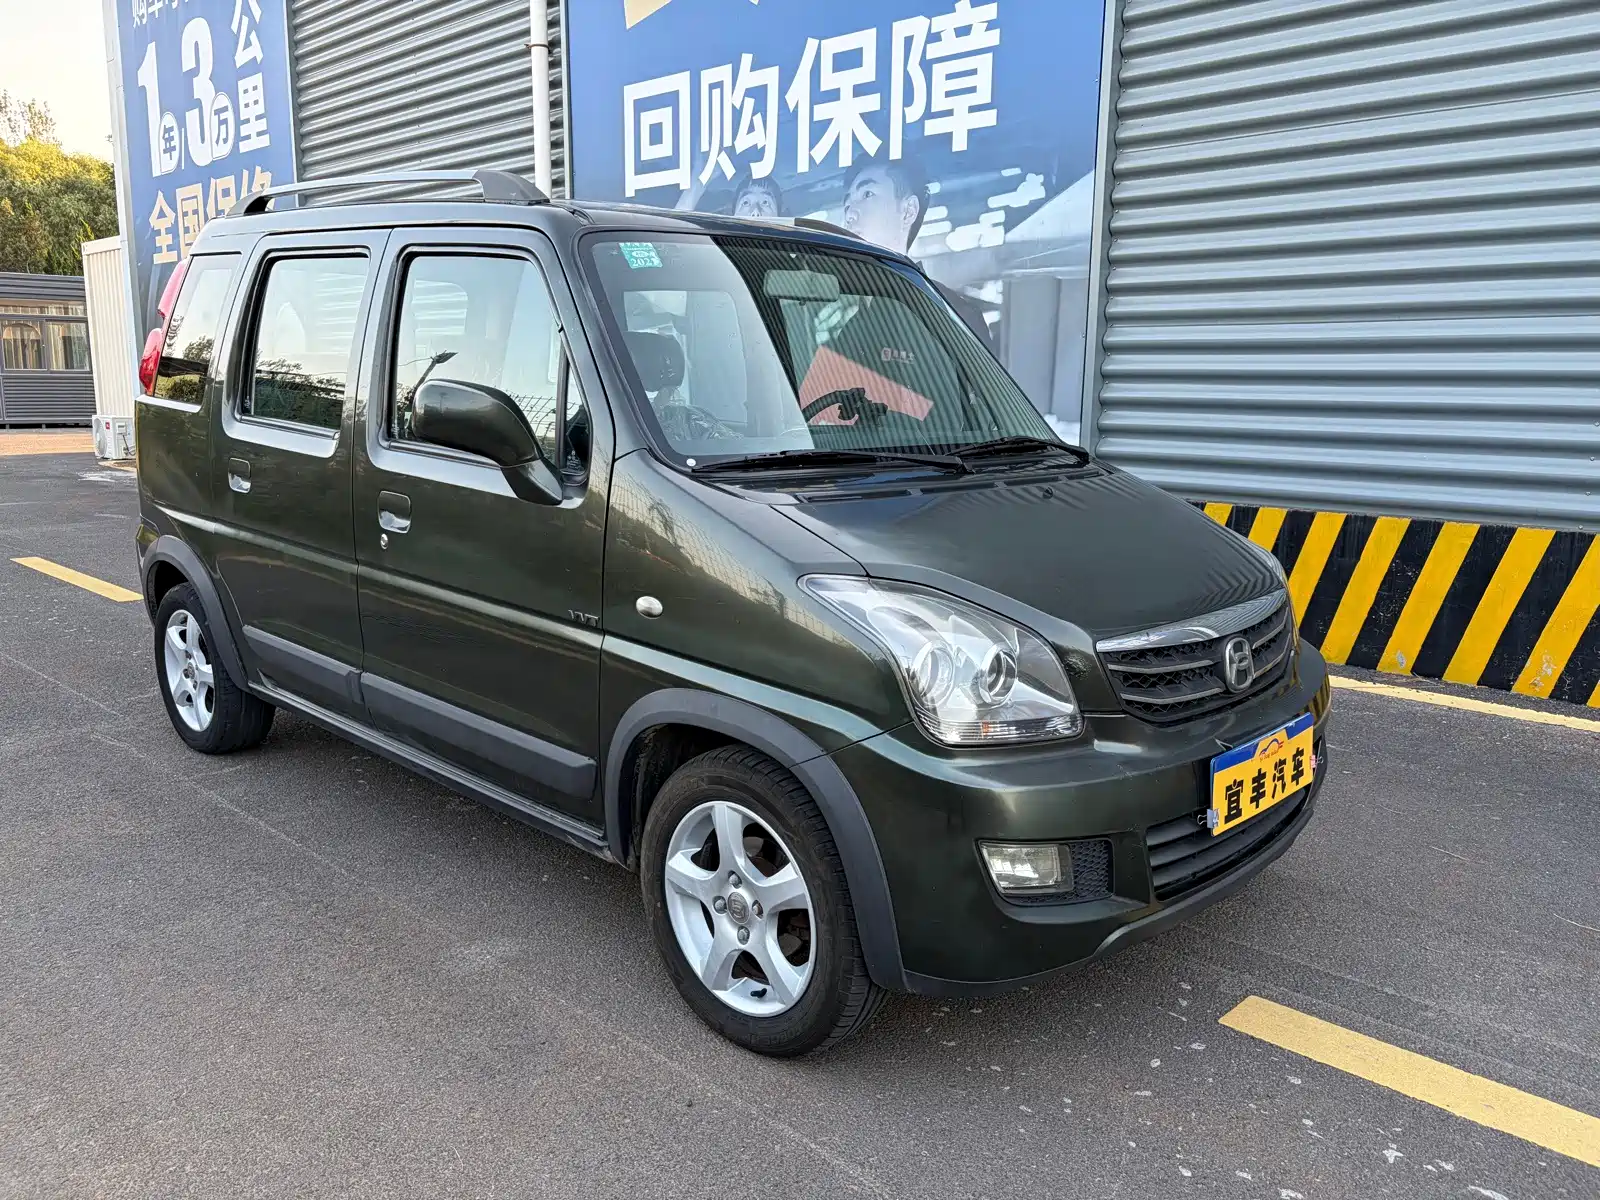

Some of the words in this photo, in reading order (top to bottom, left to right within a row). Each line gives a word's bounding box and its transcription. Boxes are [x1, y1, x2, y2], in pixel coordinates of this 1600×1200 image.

[623, 0, 1000, 198] 回购保障
[1225, 747, 1304, 824] 宜丰汽车
